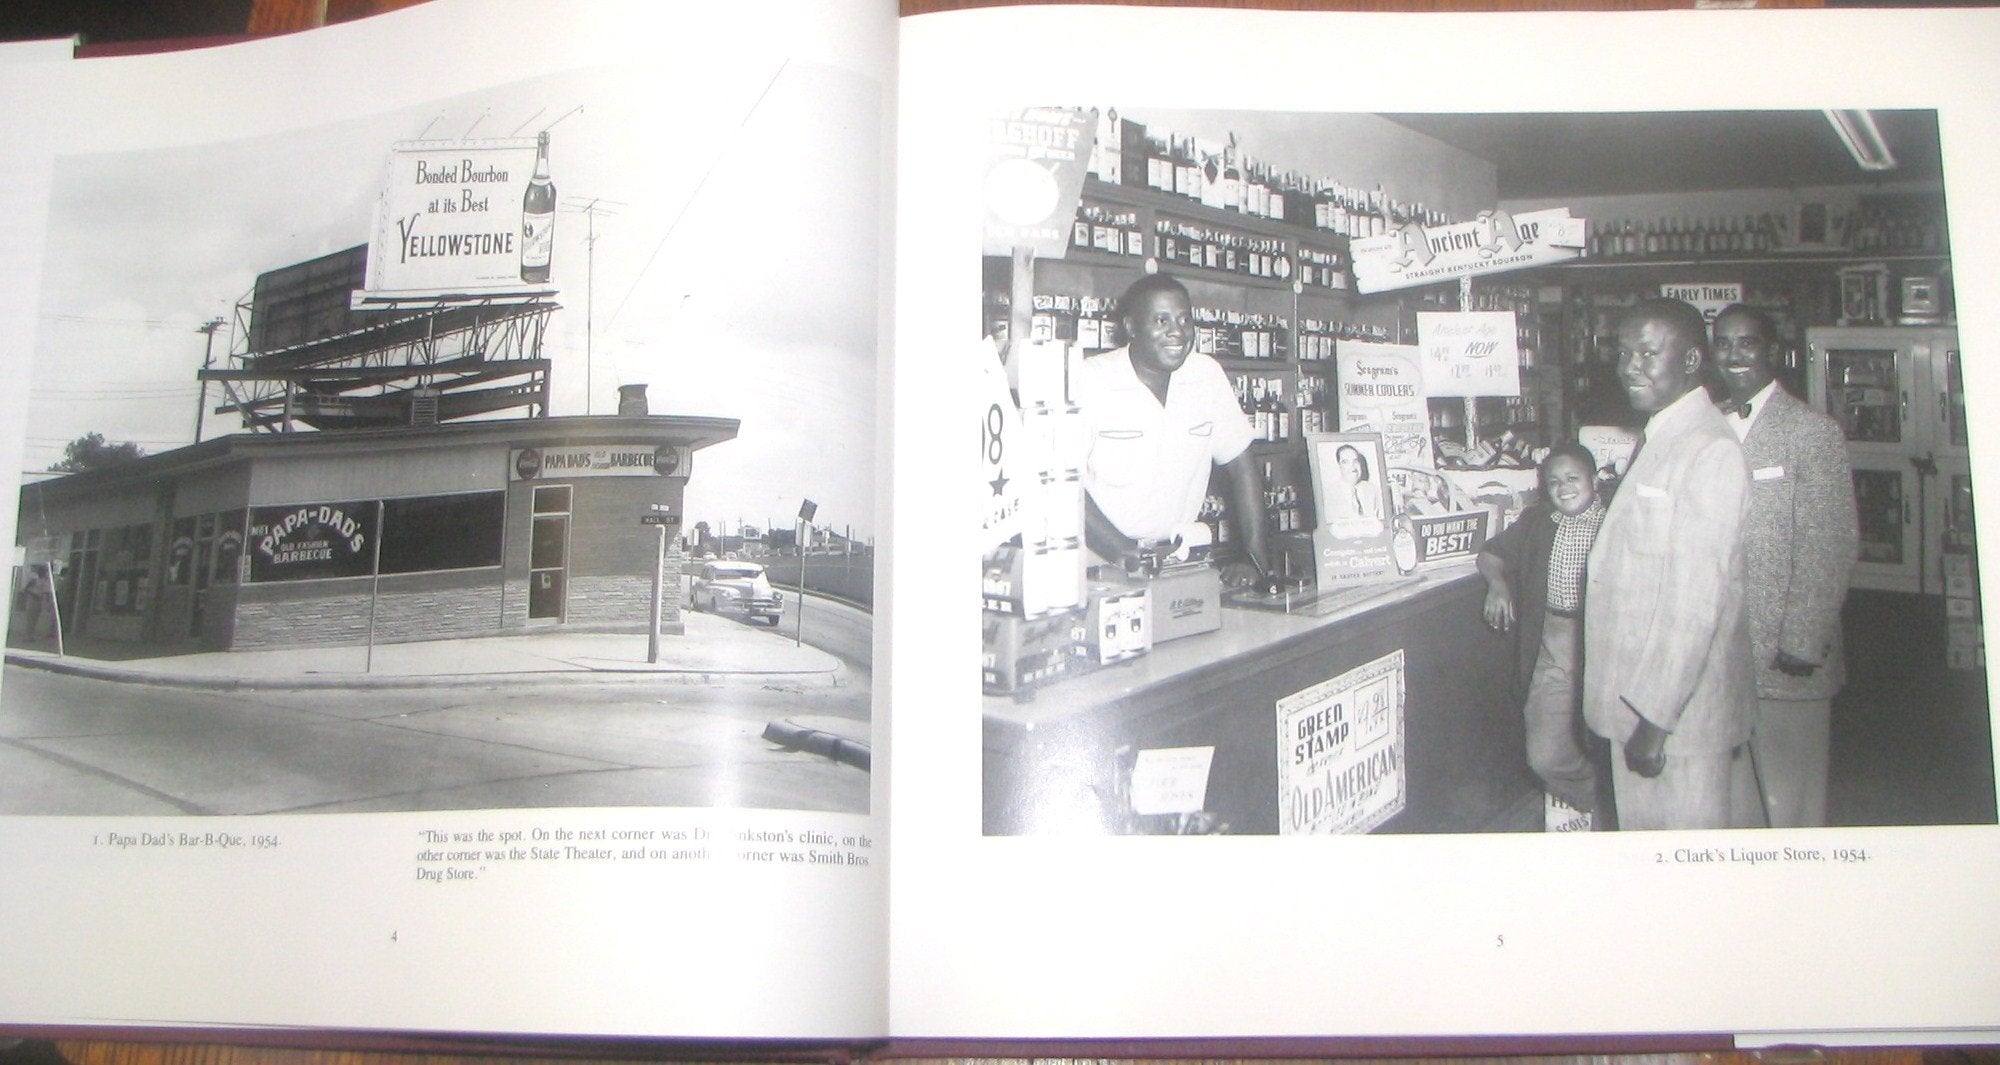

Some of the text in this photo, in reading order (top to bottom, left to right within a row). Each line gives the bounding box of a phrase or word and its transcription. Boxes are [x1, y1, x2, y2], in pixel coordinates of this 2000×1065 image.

[416, 159, 508, 184] Bonded Bourbon
[428, 189, 488, 214] at its Best
[397, 212, 514, 264] YELLOWSTONE
[1388, 209, 1539, 273] Ancient Age
[1406, 254, 1534, 279] STRAIGHT KENTUCKY BOURBON
[1667, 287, 1737, 300] EARLY TIMES
[1464, 341, 1501, 355] NOW
[1356, 360, 1398, 380] Seagram's
[1344, 383, 1415, 397] SUMMER COOLERS
[545, 454, 566, 469] PAPA
[610, 453, 654, 467] BARBECUE
[260, 506, 365, 556] PAPA-DAD'S
[1421, 518, 1479, 537] DO YOU WANT THE
[1426, 534, 1473, 555] BEST!
[274, 549, 332, 564] BARBECUE
[1298, 703, 1342, 740] GREEN
[1295, 722, 1349, 765] STAMP
[1325, 742, 1397, 809] AMERICAN
[109, 833, 137, 849] Papa
[141, 832, 175, 846] Dad's
[179, 832, 246, 848] Bar-B-Que,
[251, 835, 282, 849] 1954.
[453, 831, 473, 842] was
[478, 829, 494, 841] the
[499, 830, 526, 844] spot.
[532, 827, 550, 841] On
[555, 827, 574, 841] the
[579, 829, 606, 840] next
[611, 830, 655, 840] corner
[662, 831, 687, 840] was
[738, 829, 794, 843] nkston's
[799, 830, 838, 847] clinic,
[842, 836, 856, 846] on
[859, 835, 872, 848] the
[416, 848, 443, 861] other
[447, 850, 481, 861] corner
[485, 851, 506, 860] was
[509, 847, 527, 860] the
[531, 846, 560, 860] State
[564, 846, 616, 861] Theater,
[622, 846, 645, 859] and
[650, 850, 667, 859] on
[737, 850, 774, 862] orner
[780, 852, 805, 863] was
[809, 850, 844, 865] Smith
[1655, 846, 1872, 865] 2. Clark's Liquor Store, 1954.
[416, 867, 443, 882] Drug
[390, 930, 398, 944] 4
[1496, 934, 1504, 947] 5
